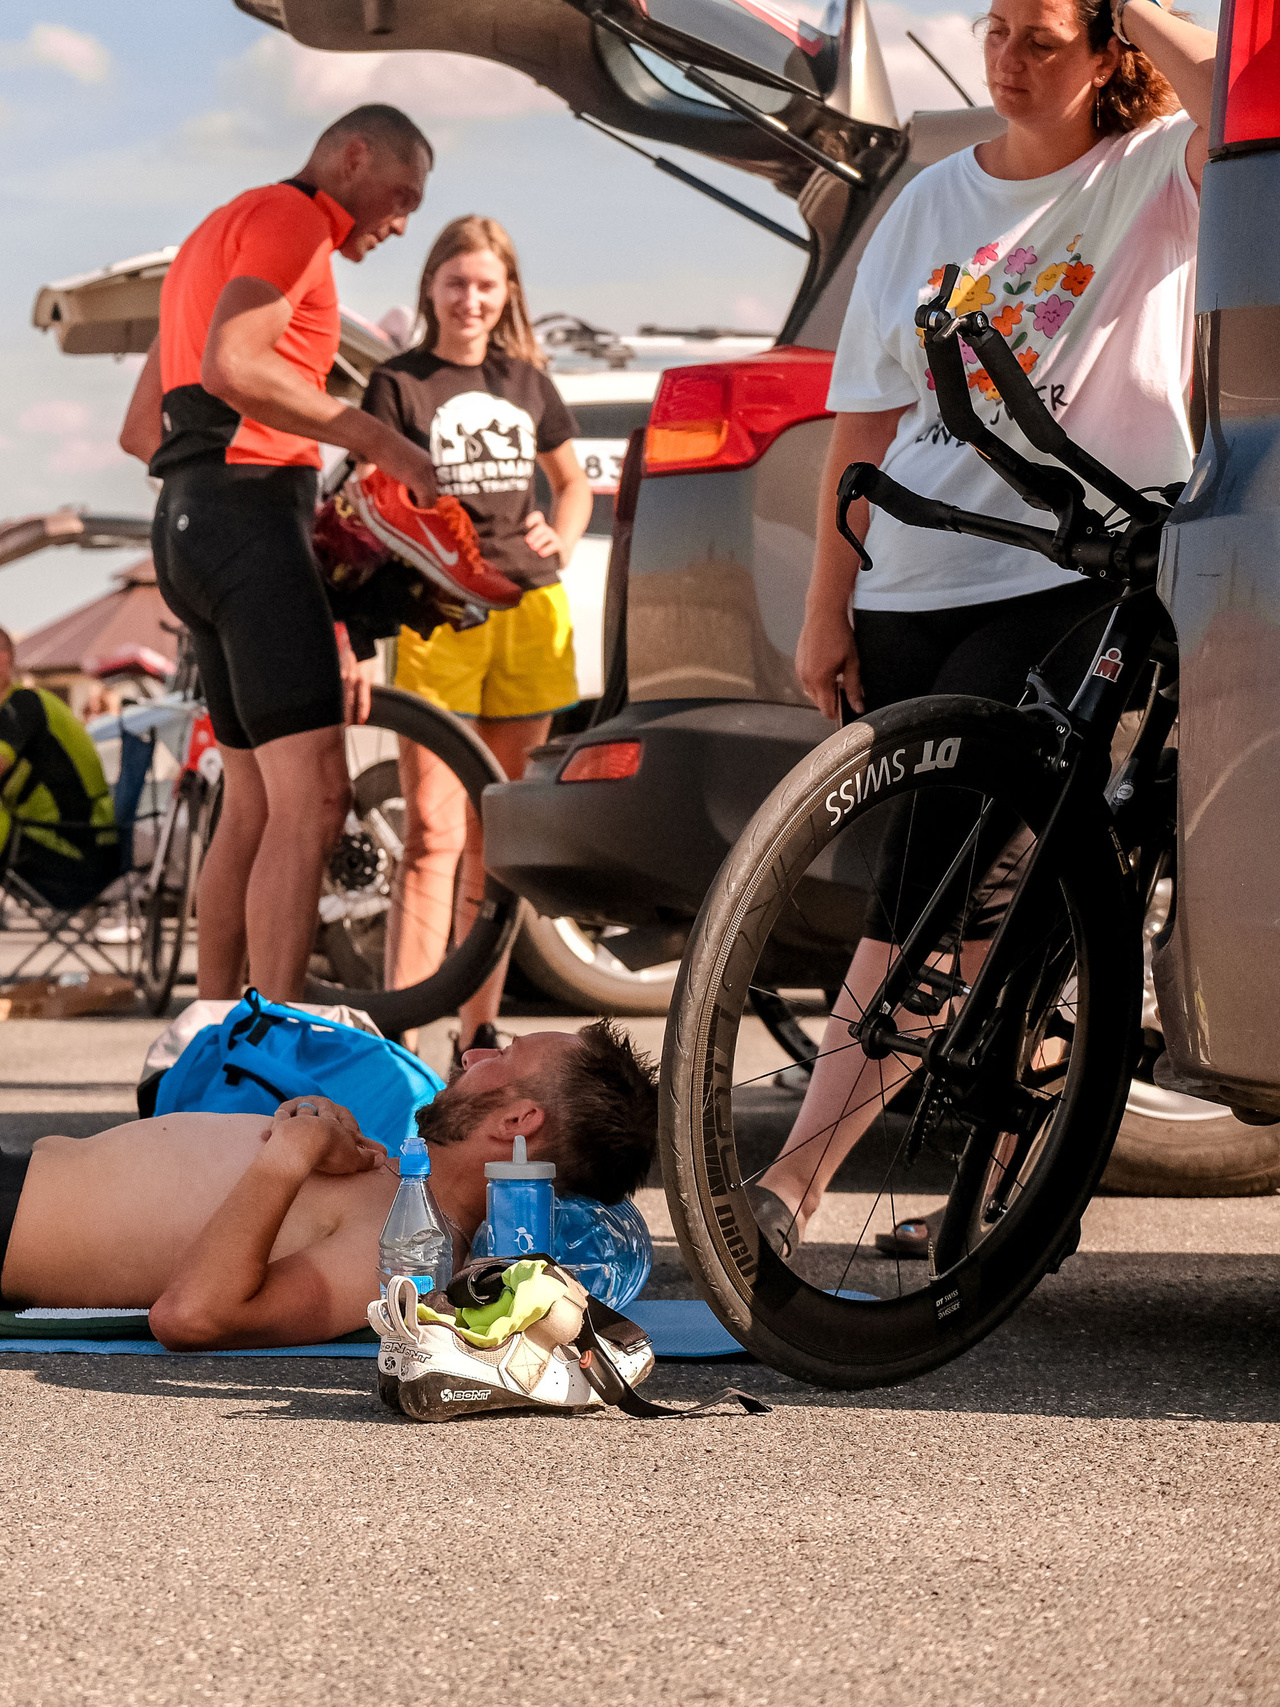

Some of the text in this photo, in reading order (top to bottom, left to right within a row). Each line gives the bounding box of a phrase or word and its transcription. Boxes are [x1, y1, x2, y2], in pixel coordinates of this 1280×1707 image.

[825, 737, 962, 827] DT SWISS
[715, 1203, 760, 1292] DiCU
[403, 1348, 432, 1363] ONT
[452, 1389, 492, 1402] BONT
